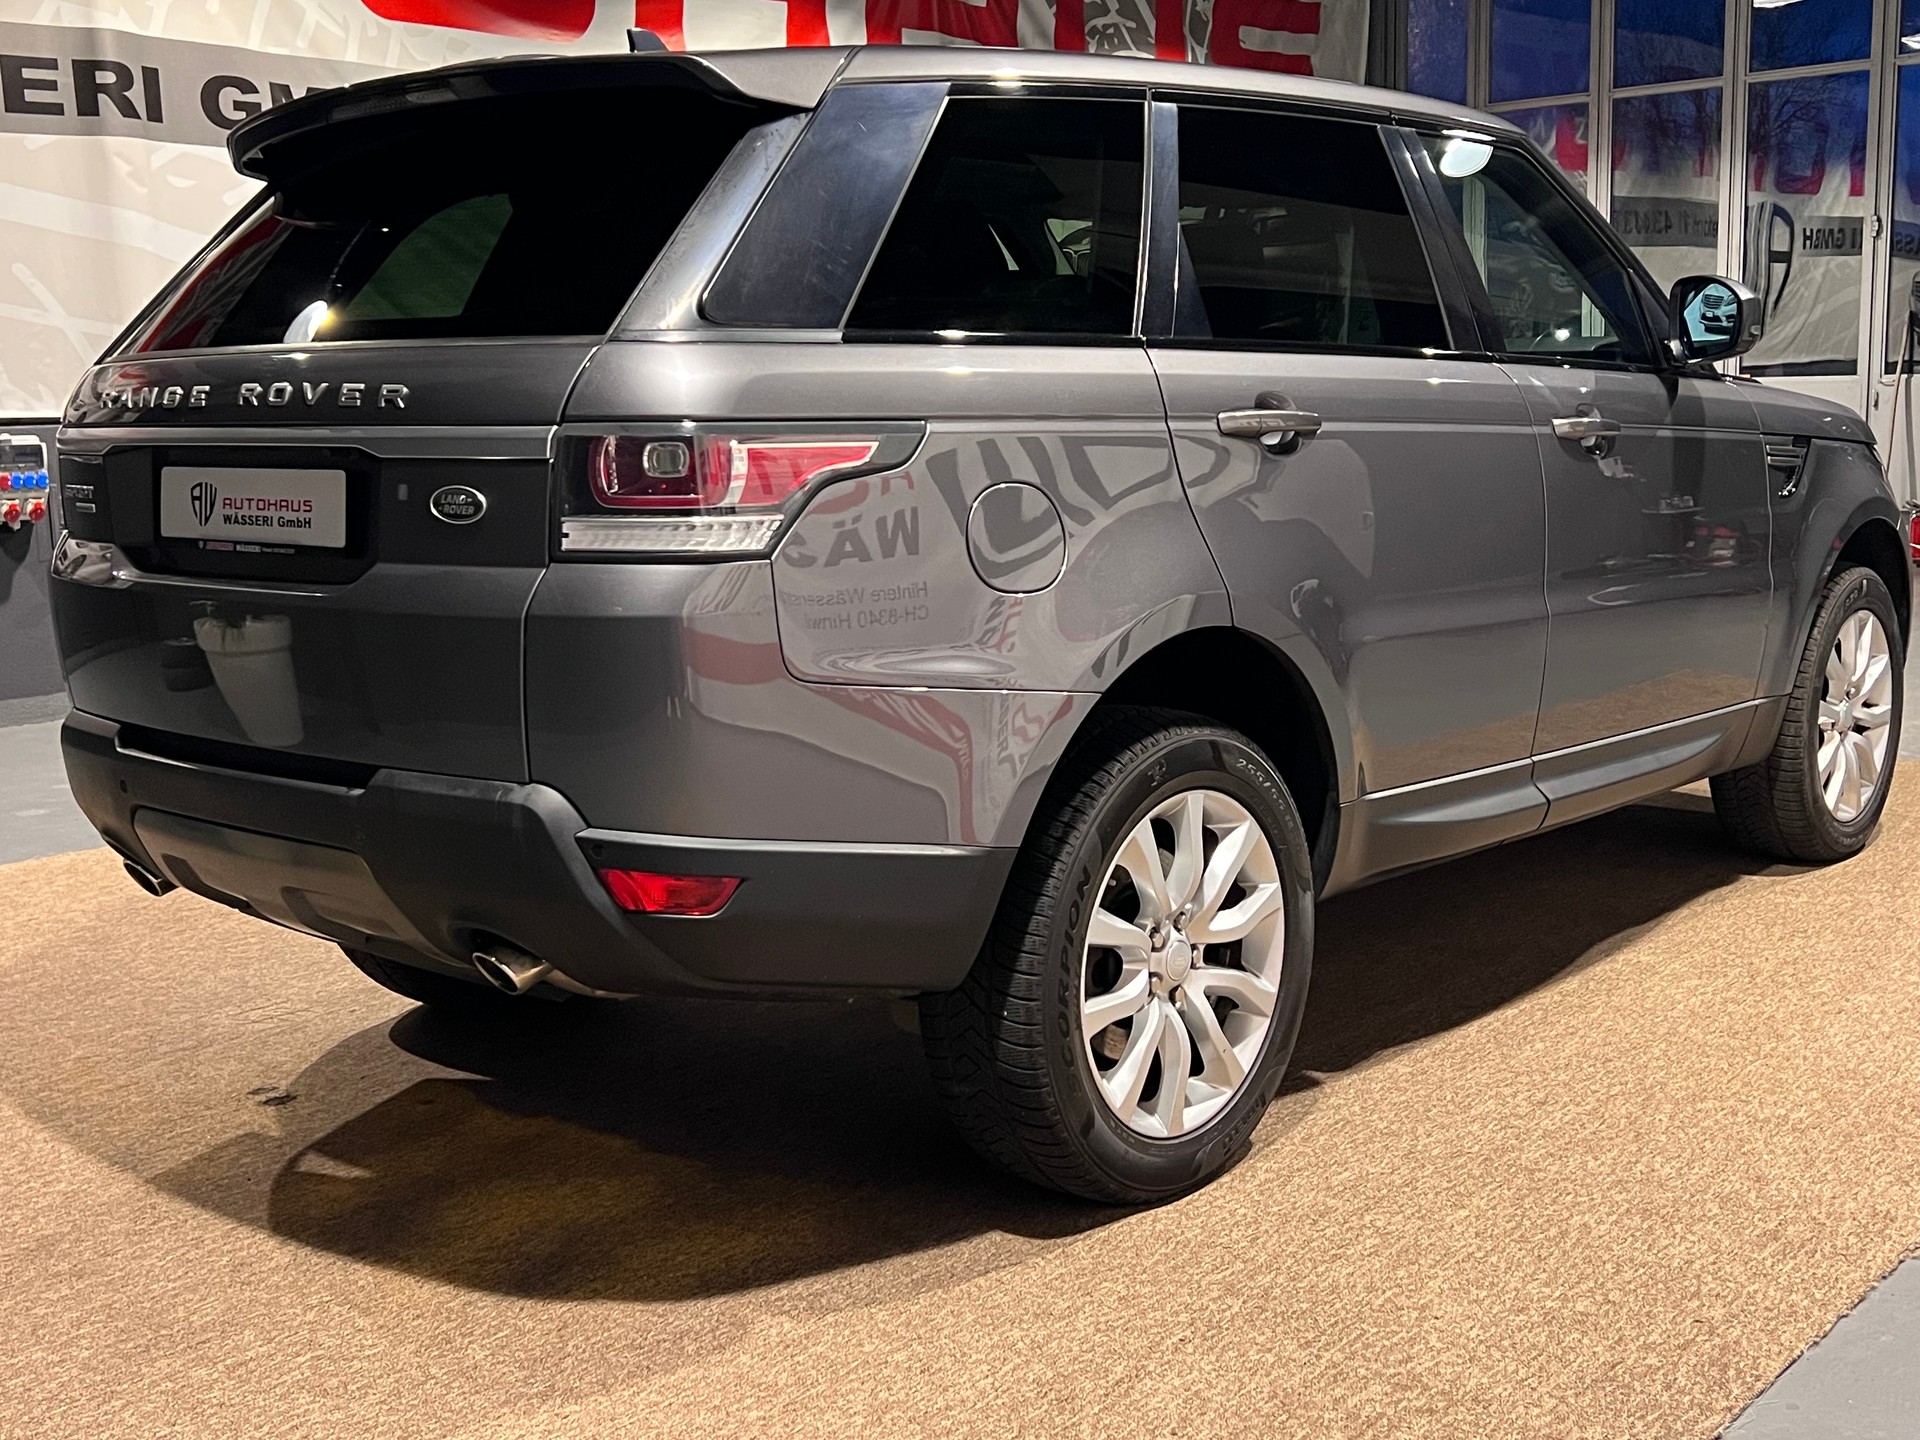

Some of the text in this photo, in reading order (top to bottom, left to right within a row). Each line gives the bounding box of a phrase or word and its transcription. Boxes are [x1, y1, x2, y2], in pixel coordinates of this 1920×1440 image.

[0, 54, 164, 124] ERI
[100, 381, 410, 409] RANGE ROVER
[222, 497, 313, 513] AUTOHAUS
[443, 504, 475, 515] ROVER
[222, 511, 312, 529] WÄSSERI GmbH
